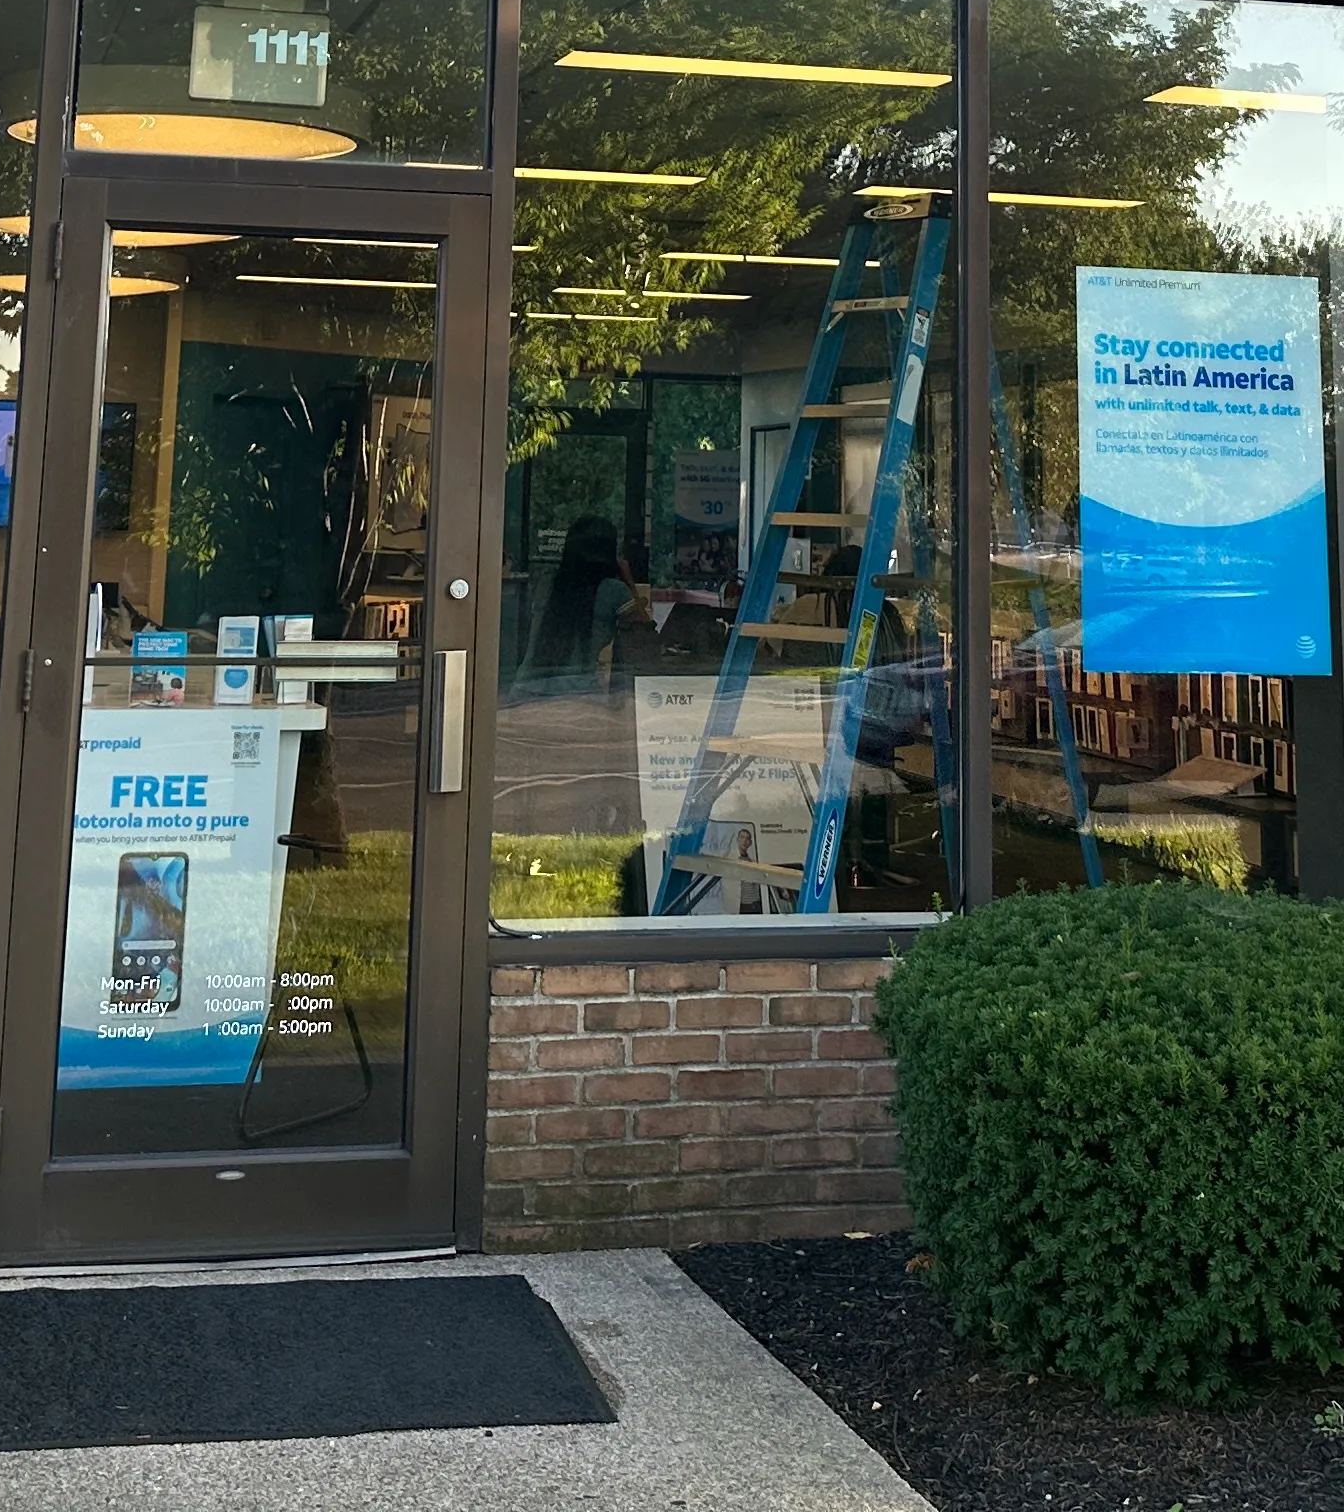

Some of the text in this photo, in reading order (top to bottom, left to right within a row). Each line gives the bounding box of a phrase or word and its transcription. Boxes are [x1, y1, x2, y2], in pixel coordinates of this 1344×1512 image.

[248, 28, 329, 65] 1111
[1088, 276, 1201, 290] AT&T Unlimited Premium
[1094, 333, 1284, 362] Stay connected
[1095, 361, 1294, 391] in Latin America
[1095, 398, 1301, 417] with unlimited talk, text, & data
[1151, 431, 1164, 440] en
[1240, 434, 1259, 443] con
[1145, 444, 1179, 455] textos
[1179, 446, 1188, 457] y
[665, 694, 694, 706] AT&T
[90, 737, 141, 752] prepaid
[650, 755, 675, 765] New
[110, 775, 209, 808] FREE
[147, 814, 193, 828] moto
[196, 816, 207, 831] g
[211, 815, 249, 831] pure
[96, 836, 111, 845] you
[111, 835, 131, 845] bring
[131, 836, 148, 845] your
[149, 834, 178, 842] number
[188, 833, 208, 842] AT&T
[208, 833, 237, 843] Prepaid
[819, 823, 835, 879] WERNER
[101, 975, 162, 991] Mon-Fri
[206, 974, 266, 989] 10:00am
[280, 972, 335, 991] 8:00pm
[99, 1000, 170, 1018] Saturday
[204, 998, 265, 1013] 10:00am
[287, 996, 334, 1014] :00pm
[97, 1023, 155, 1042] Sunday
[202, 1021, 263, 1037] 1:00am
[279, 1019, 333, 1037] 5:00pm
